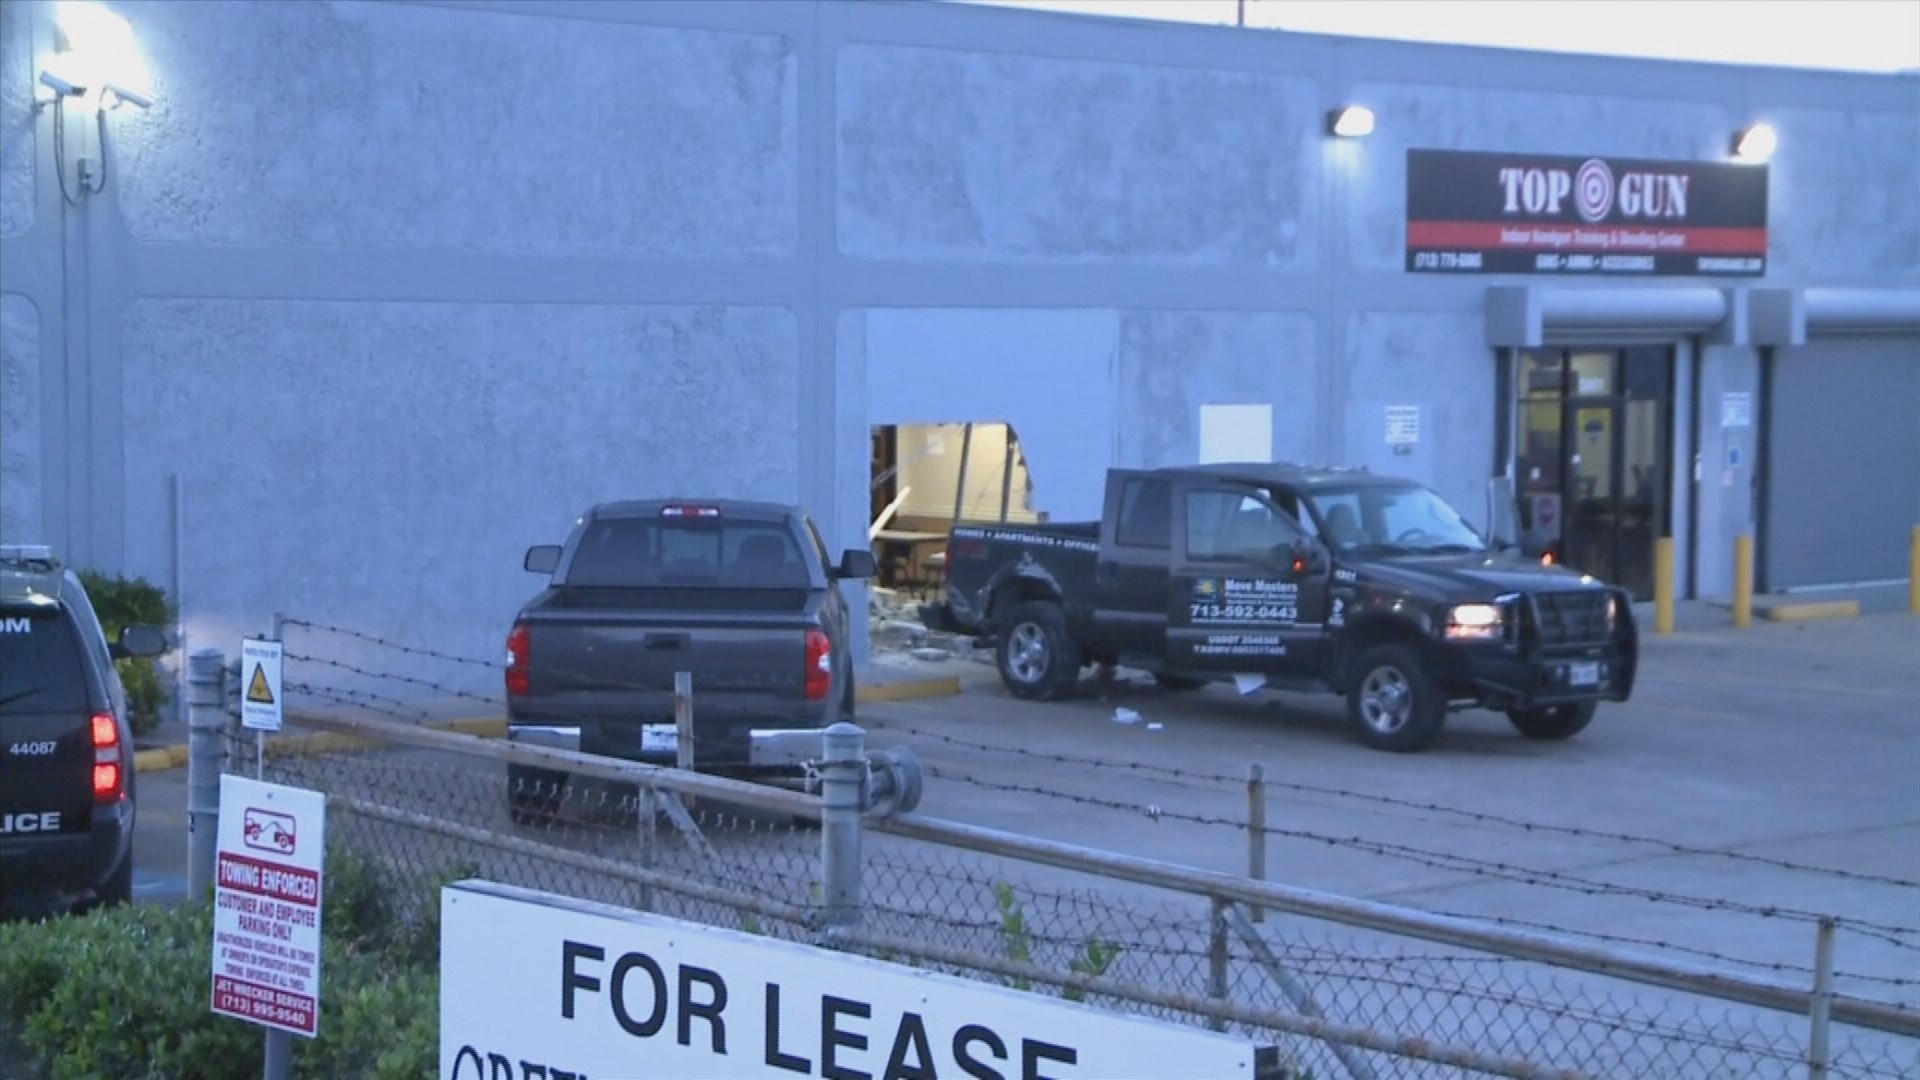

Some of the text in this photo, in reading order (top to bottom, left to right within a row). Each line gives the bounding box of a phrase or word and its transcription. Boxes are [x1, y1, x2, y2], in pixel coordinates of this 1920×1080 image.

[1499, 167, 1689, 218] TOP GUN
[993, 531, 1055, 546] APARTMENTS
[1224, 578, 1298, 593] Move Masters
[1190, 604, 1298, 619] 713-592-0443
[9, 740, 57, 755] 44087
[220, 859, 317, 900] TOWING ENFORCED
[218, 891, 315, 929] CUSTOMER AND EMPLOYEE
[238, 913, 292, 942] PARKING ONLY
[216, 979, 312, 1012] JET WRECKER SERVICE
[222, 994, 250, 1016] (713)
[561, 938, 1078, 1080] FOR LEASE
